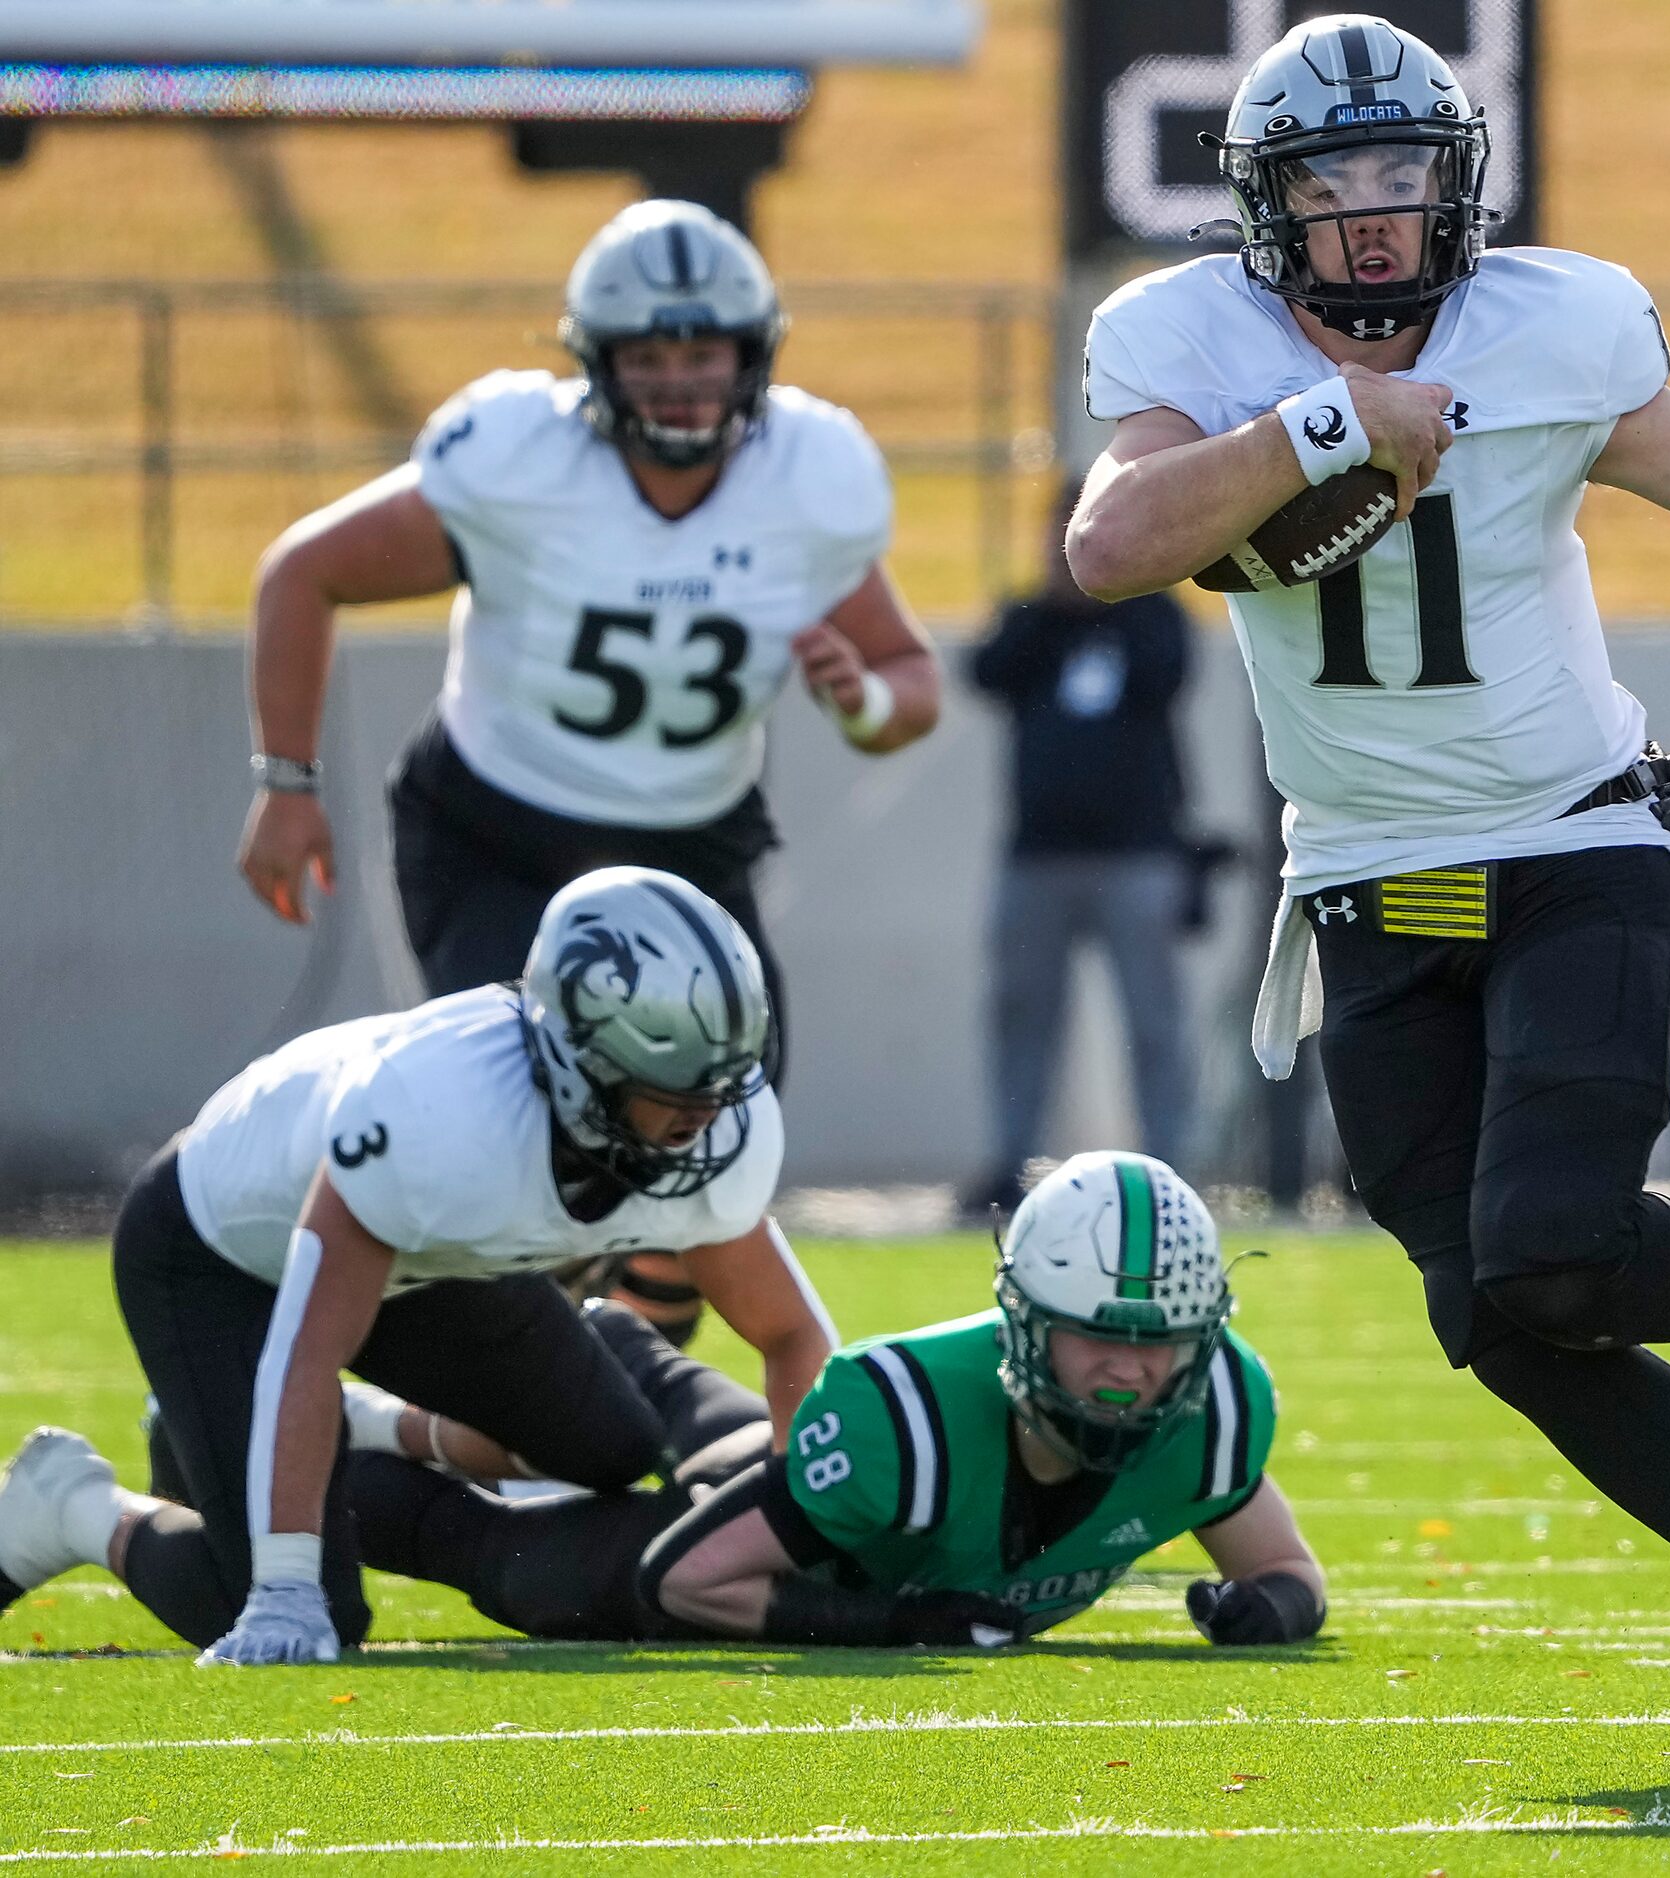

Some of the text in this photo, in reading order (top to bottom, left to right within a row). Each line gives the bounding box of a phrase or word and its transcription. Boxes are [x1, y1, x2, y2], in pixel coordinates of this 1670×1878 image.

[1337, 105, 1401, 123] WILDCATS
[1310, 491, 1486, 690] 11
[553, 603, 750, 749] 53
[332, 1121, 388, 1170] 3
[797, 1411, 852, 1492] 28
